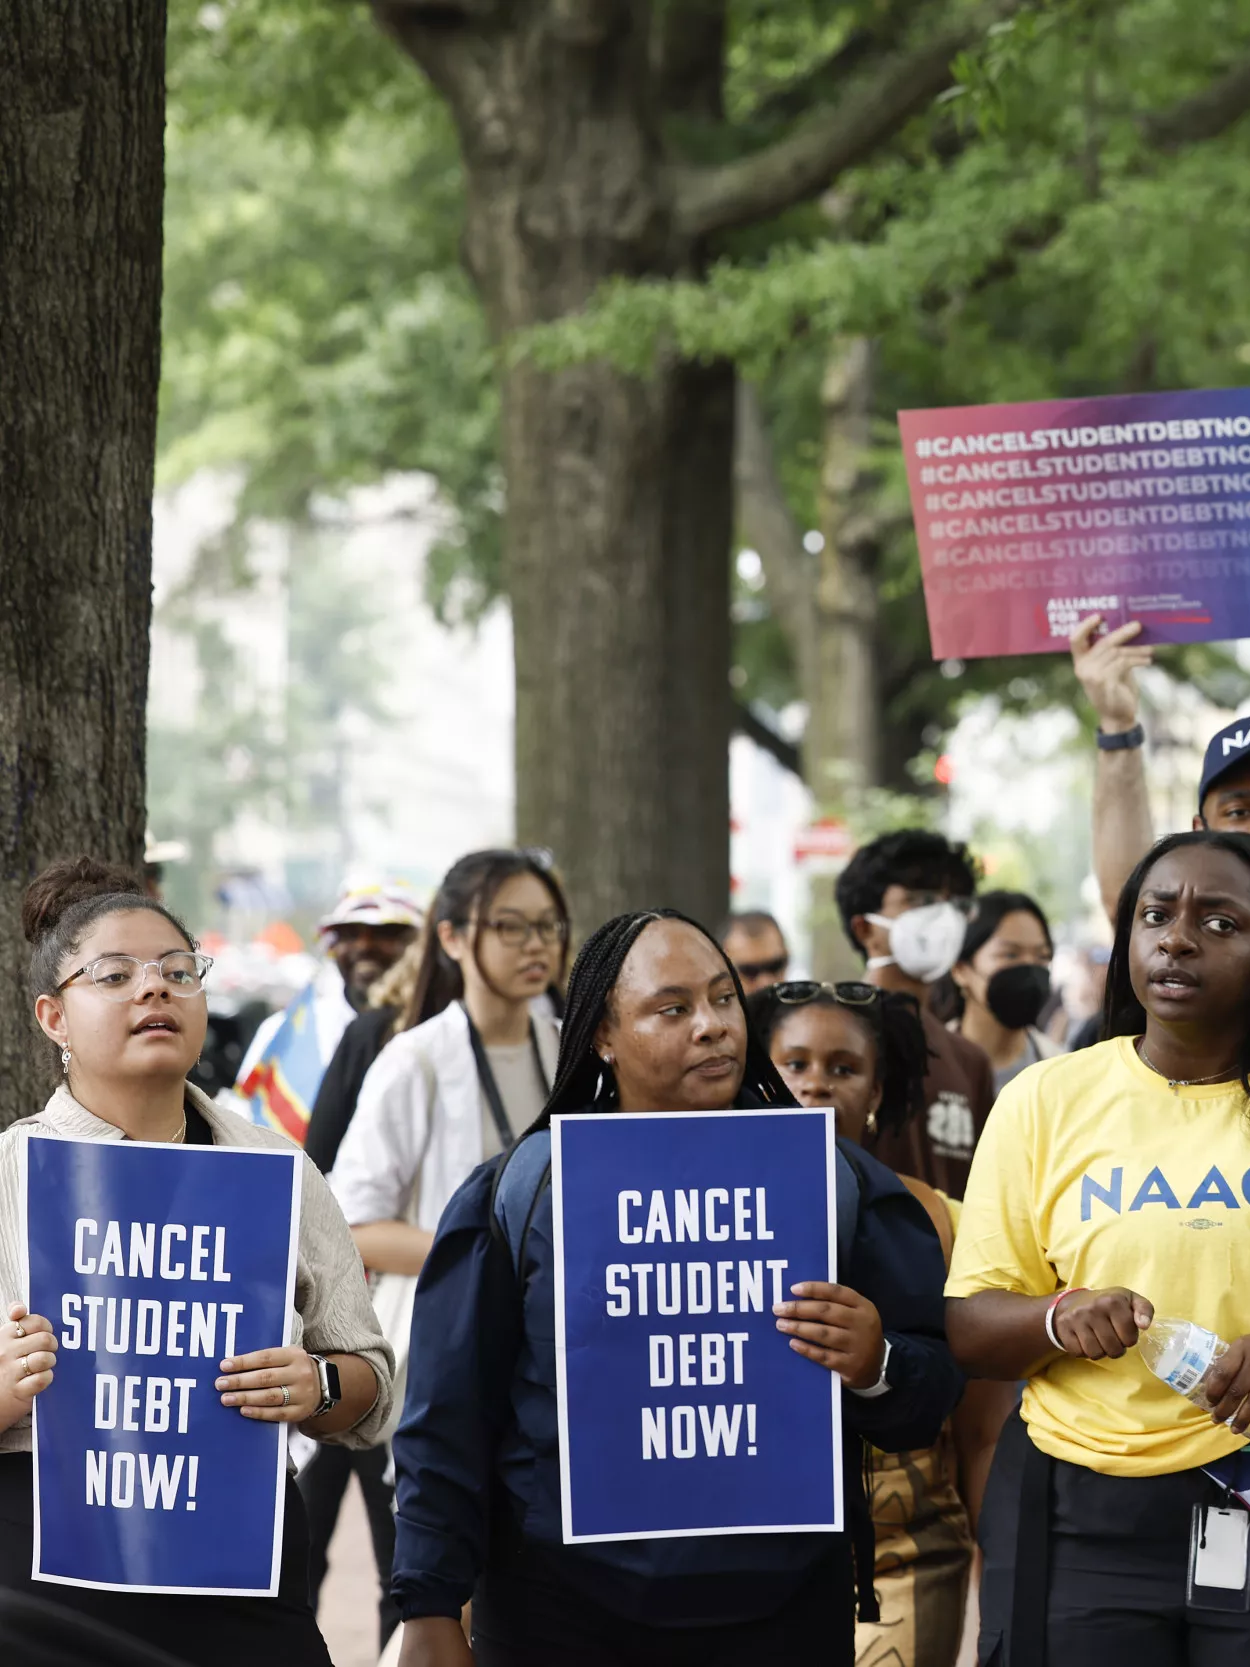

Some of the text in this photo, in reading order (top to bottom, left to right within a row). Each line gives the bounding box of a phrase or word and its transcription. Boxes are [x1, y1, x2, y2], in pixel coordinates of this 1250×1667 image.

[1047, 594, 1119, 611] ALLIANCE
[1048, 610, 1080, 623] FOR
[618, 1187, 774, 1244] CANCEL
[74, 1218, 231, 1282] CANCEL
[605, 1260, 788, 1317] STUDENT
[61, 1294, 244, 1358] STUDENT
[648, 1332, 749, 1387] DEBT
[94, 1373, 197, 1434] DEBT
[642, 1404, 758, 1460] NOW!
[86, 1450, 199, 1511] NOW!
